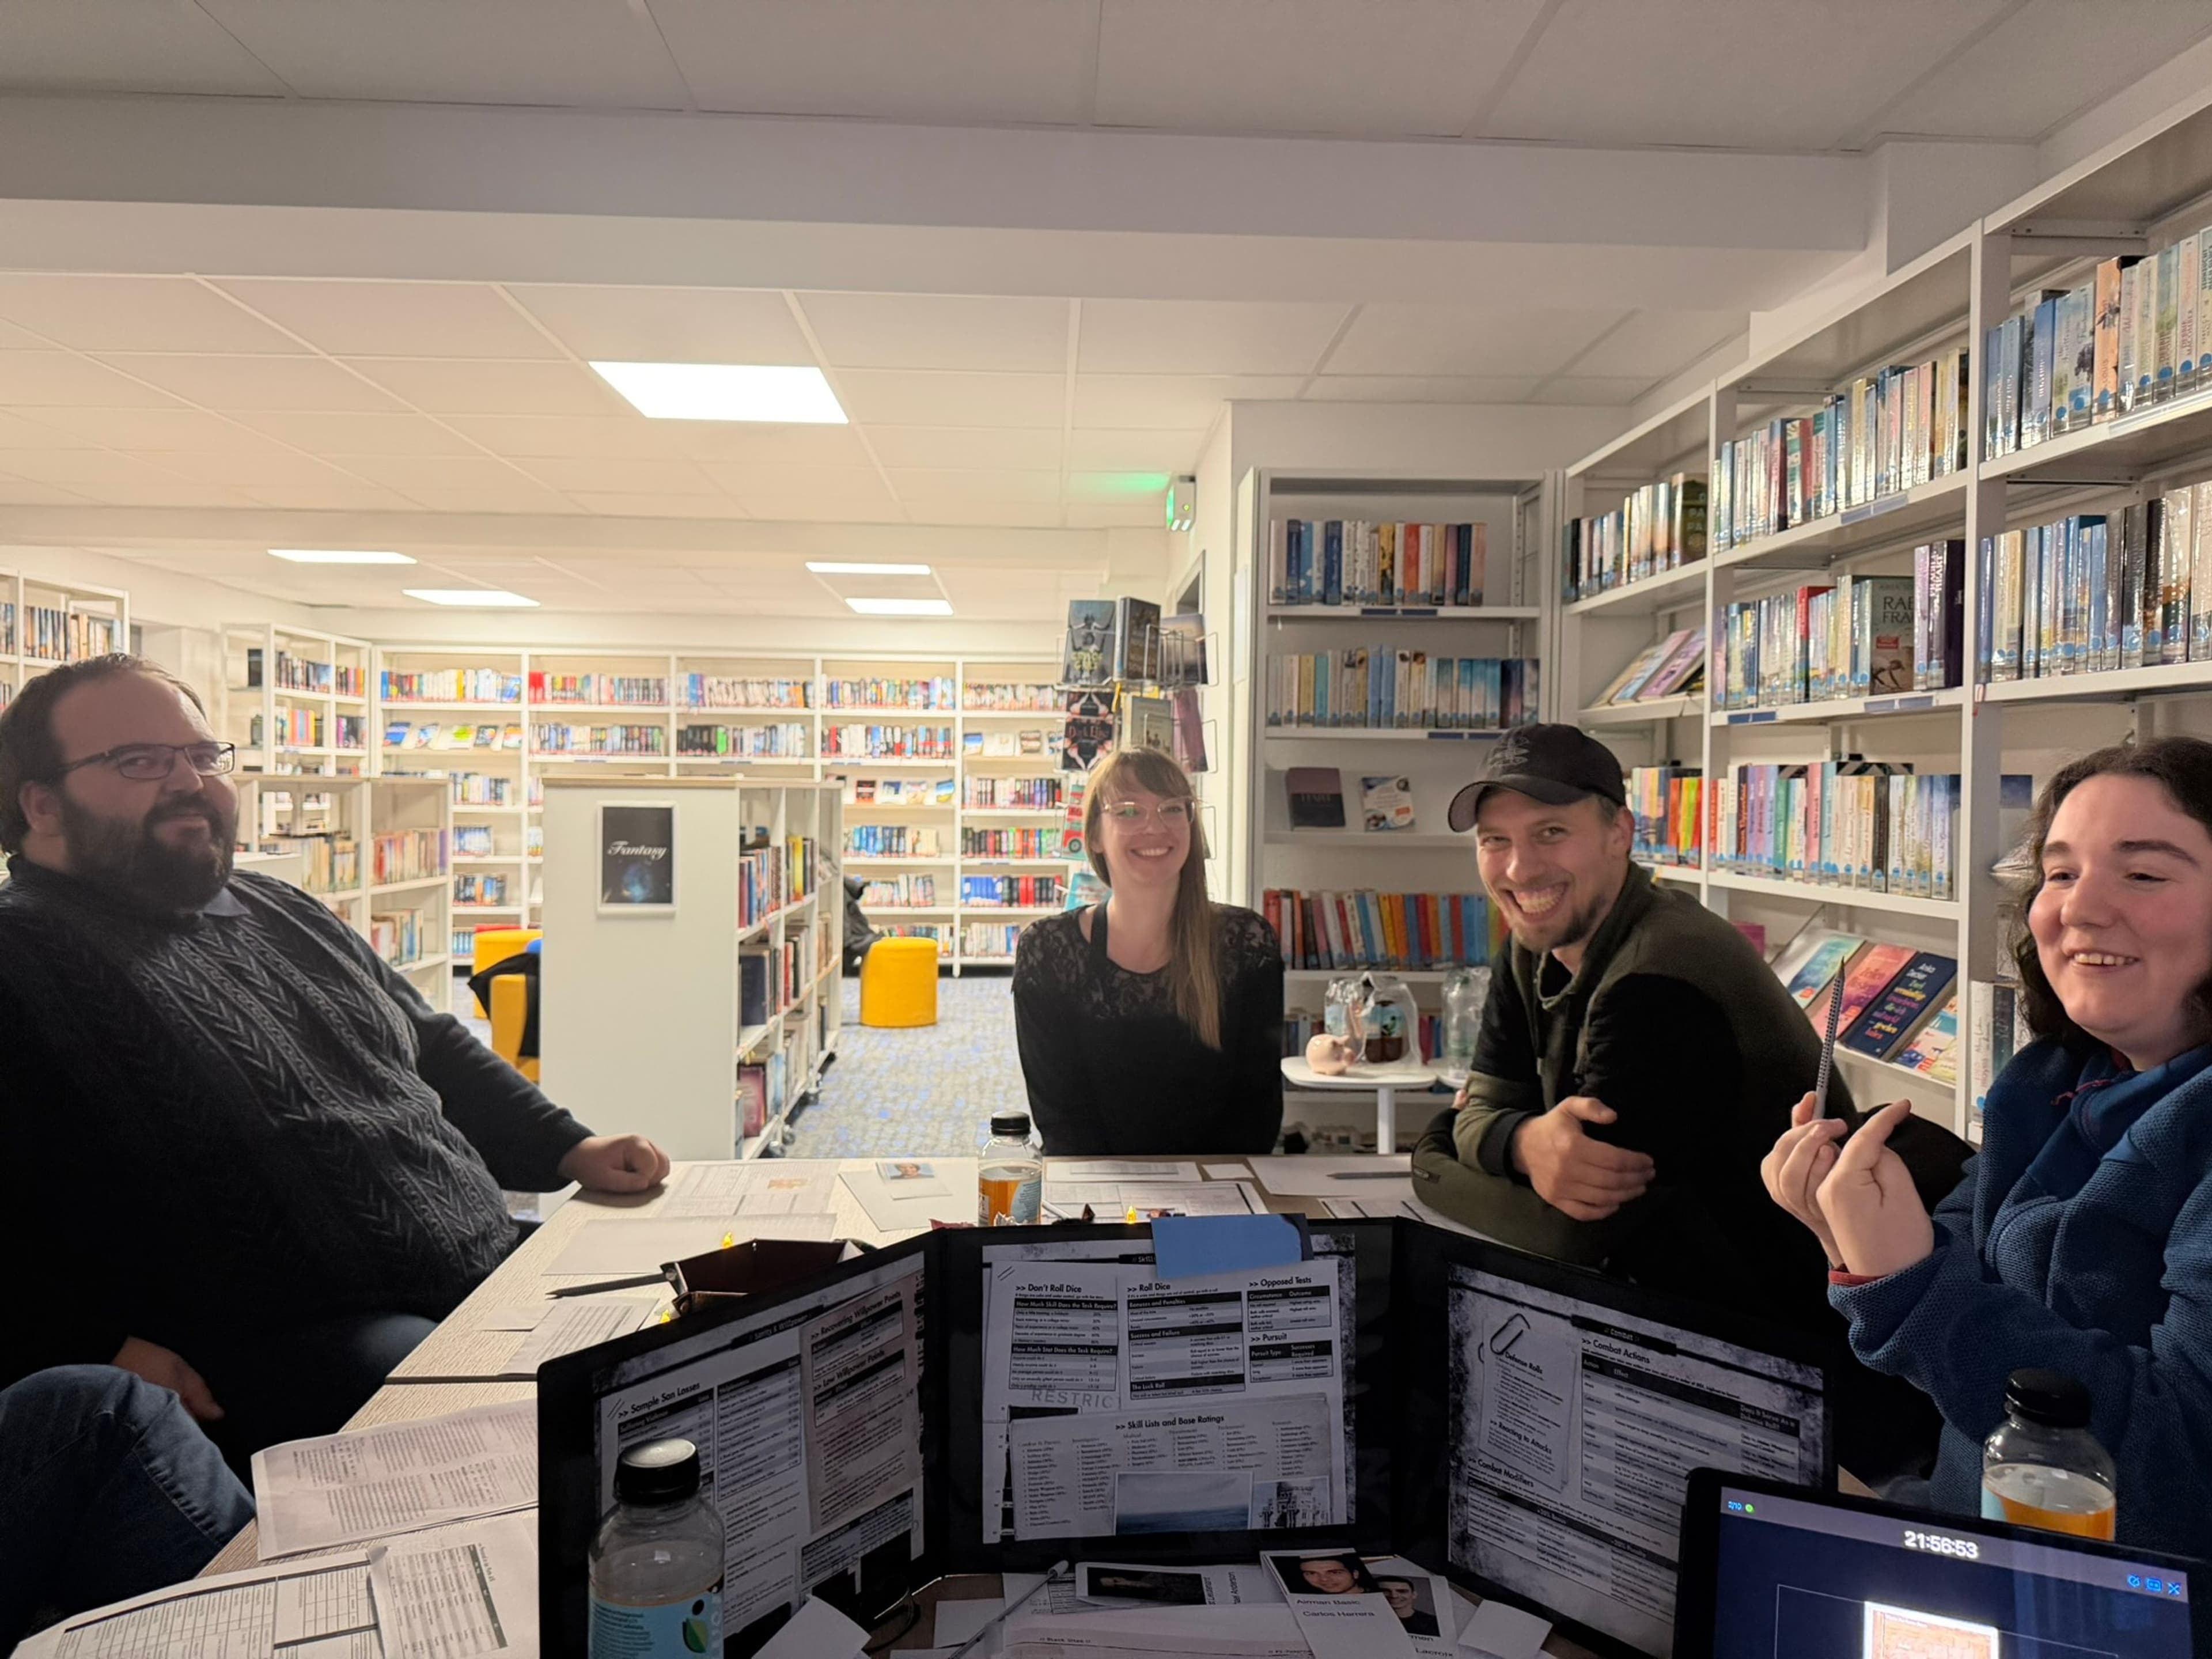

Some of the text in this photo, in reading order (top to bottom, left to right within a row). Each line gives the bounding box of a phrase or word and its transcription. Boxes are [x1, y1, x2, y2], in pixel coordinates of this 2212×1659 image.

[607, 840, 667, 861] Fantasy
[1028, 1284, 1082, 1293] Don't Roll Dice
[1260, 1277, 1293, 1287] Opposed
[821, 1292, 900, 1332] Recovering Willpower Points
[1263, 1333, 1287, 1341] Pursuit
[1610, 1328, 1633, 1340] Combat
[1593, 1340, 1649, 1362] Combat Actions
[823, 1350, 884, 1385] Low Willpower Points
[1505, 1354, 1543, 1373] Defense Rolls
[1584, 1360, 1628, 1378] Action Effect
[631, 1382, 699, 1412] Sample San Losses
[645, 1411, 668, 1422] Violence
[1127, 1415, 1225, 1429] Skill Lists and Base Ratings
[1498, 1424, 1522, 1438] Reacting
[1531, 1440, 1551, 1452] Attacks
[1478, 1460, 1534, 1486] Combat Modifiers
[1904, 1530, 1979, 1559] 21:56:53
[1415, 1647, 1453, 1657] Lacroix
